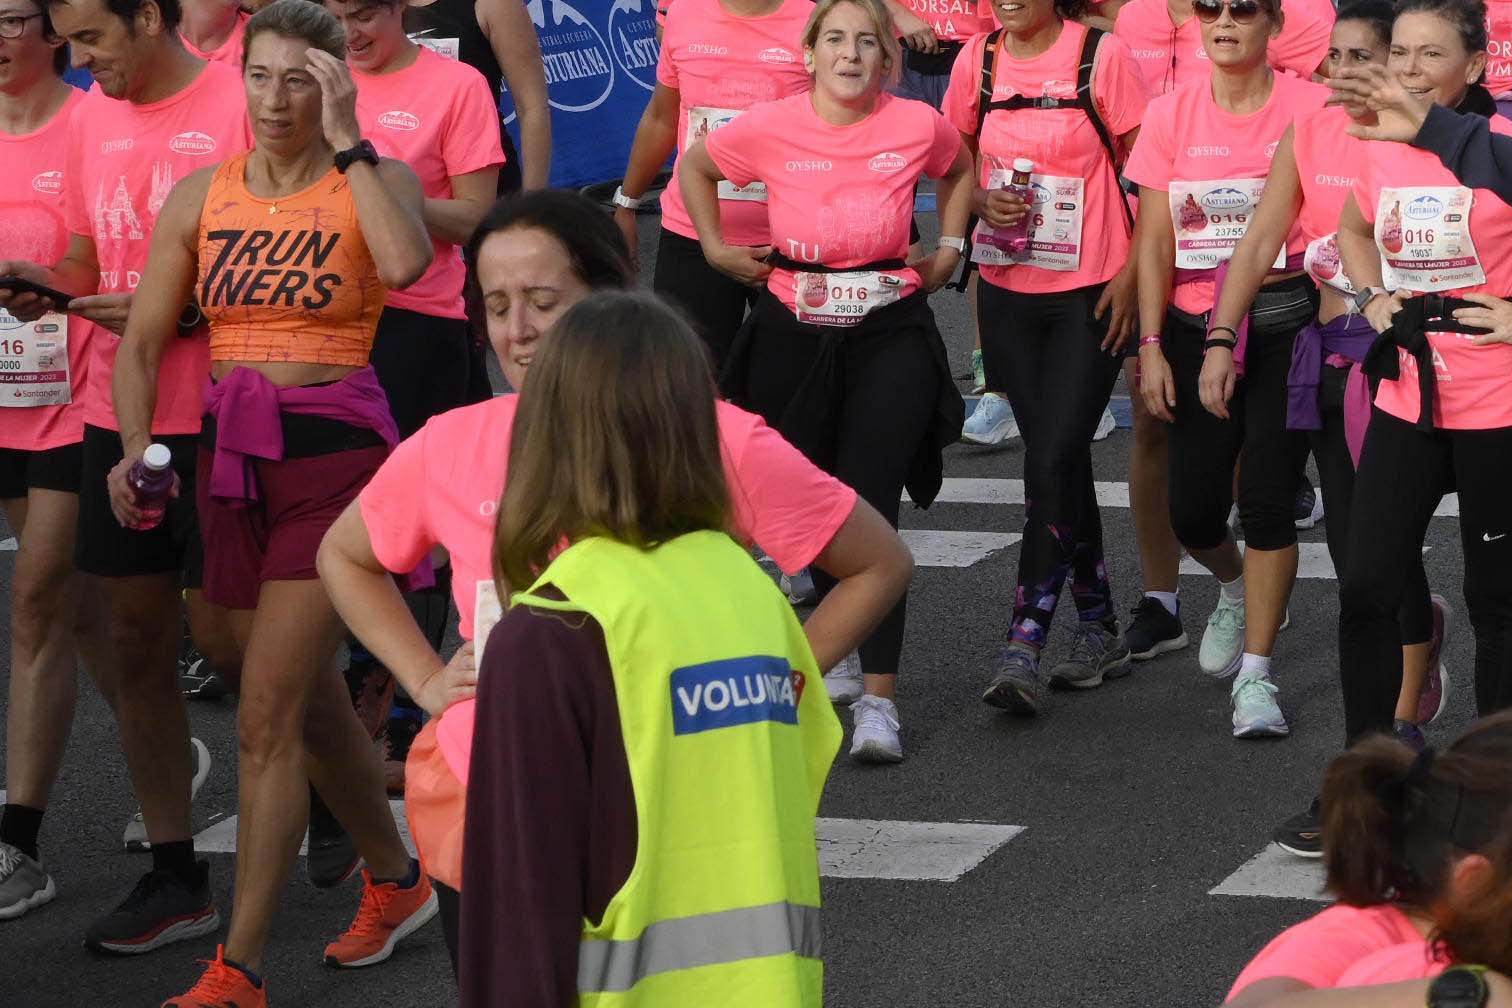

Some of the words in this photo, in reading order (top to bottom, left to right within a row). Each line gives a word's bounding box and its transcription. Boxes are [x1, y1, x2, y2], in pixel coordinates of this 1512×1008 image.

[688, 45, 728, 55] OYSHO
[1187, 145, 1230, 157] OYSHO
[786, 160, 833, 172] OYSHO
[1205, 195, 1246, 206] ASTURIANA
[1210, 213, 1247, 224] 016
[1215, 227, 1244, 237] 23755
[1405, 228, 1435, 244] 016
[785, 238, 820, 263] TU
[1186, 254, 1217, 263] OYSHO
[832, 286, 868, 301] 016
[834, 304, 864, 315] 29038
[808, 315, 836, 324] CARRERA
[836, 316, 847, 324] DE
[22, 389, 61, 398] Santander
